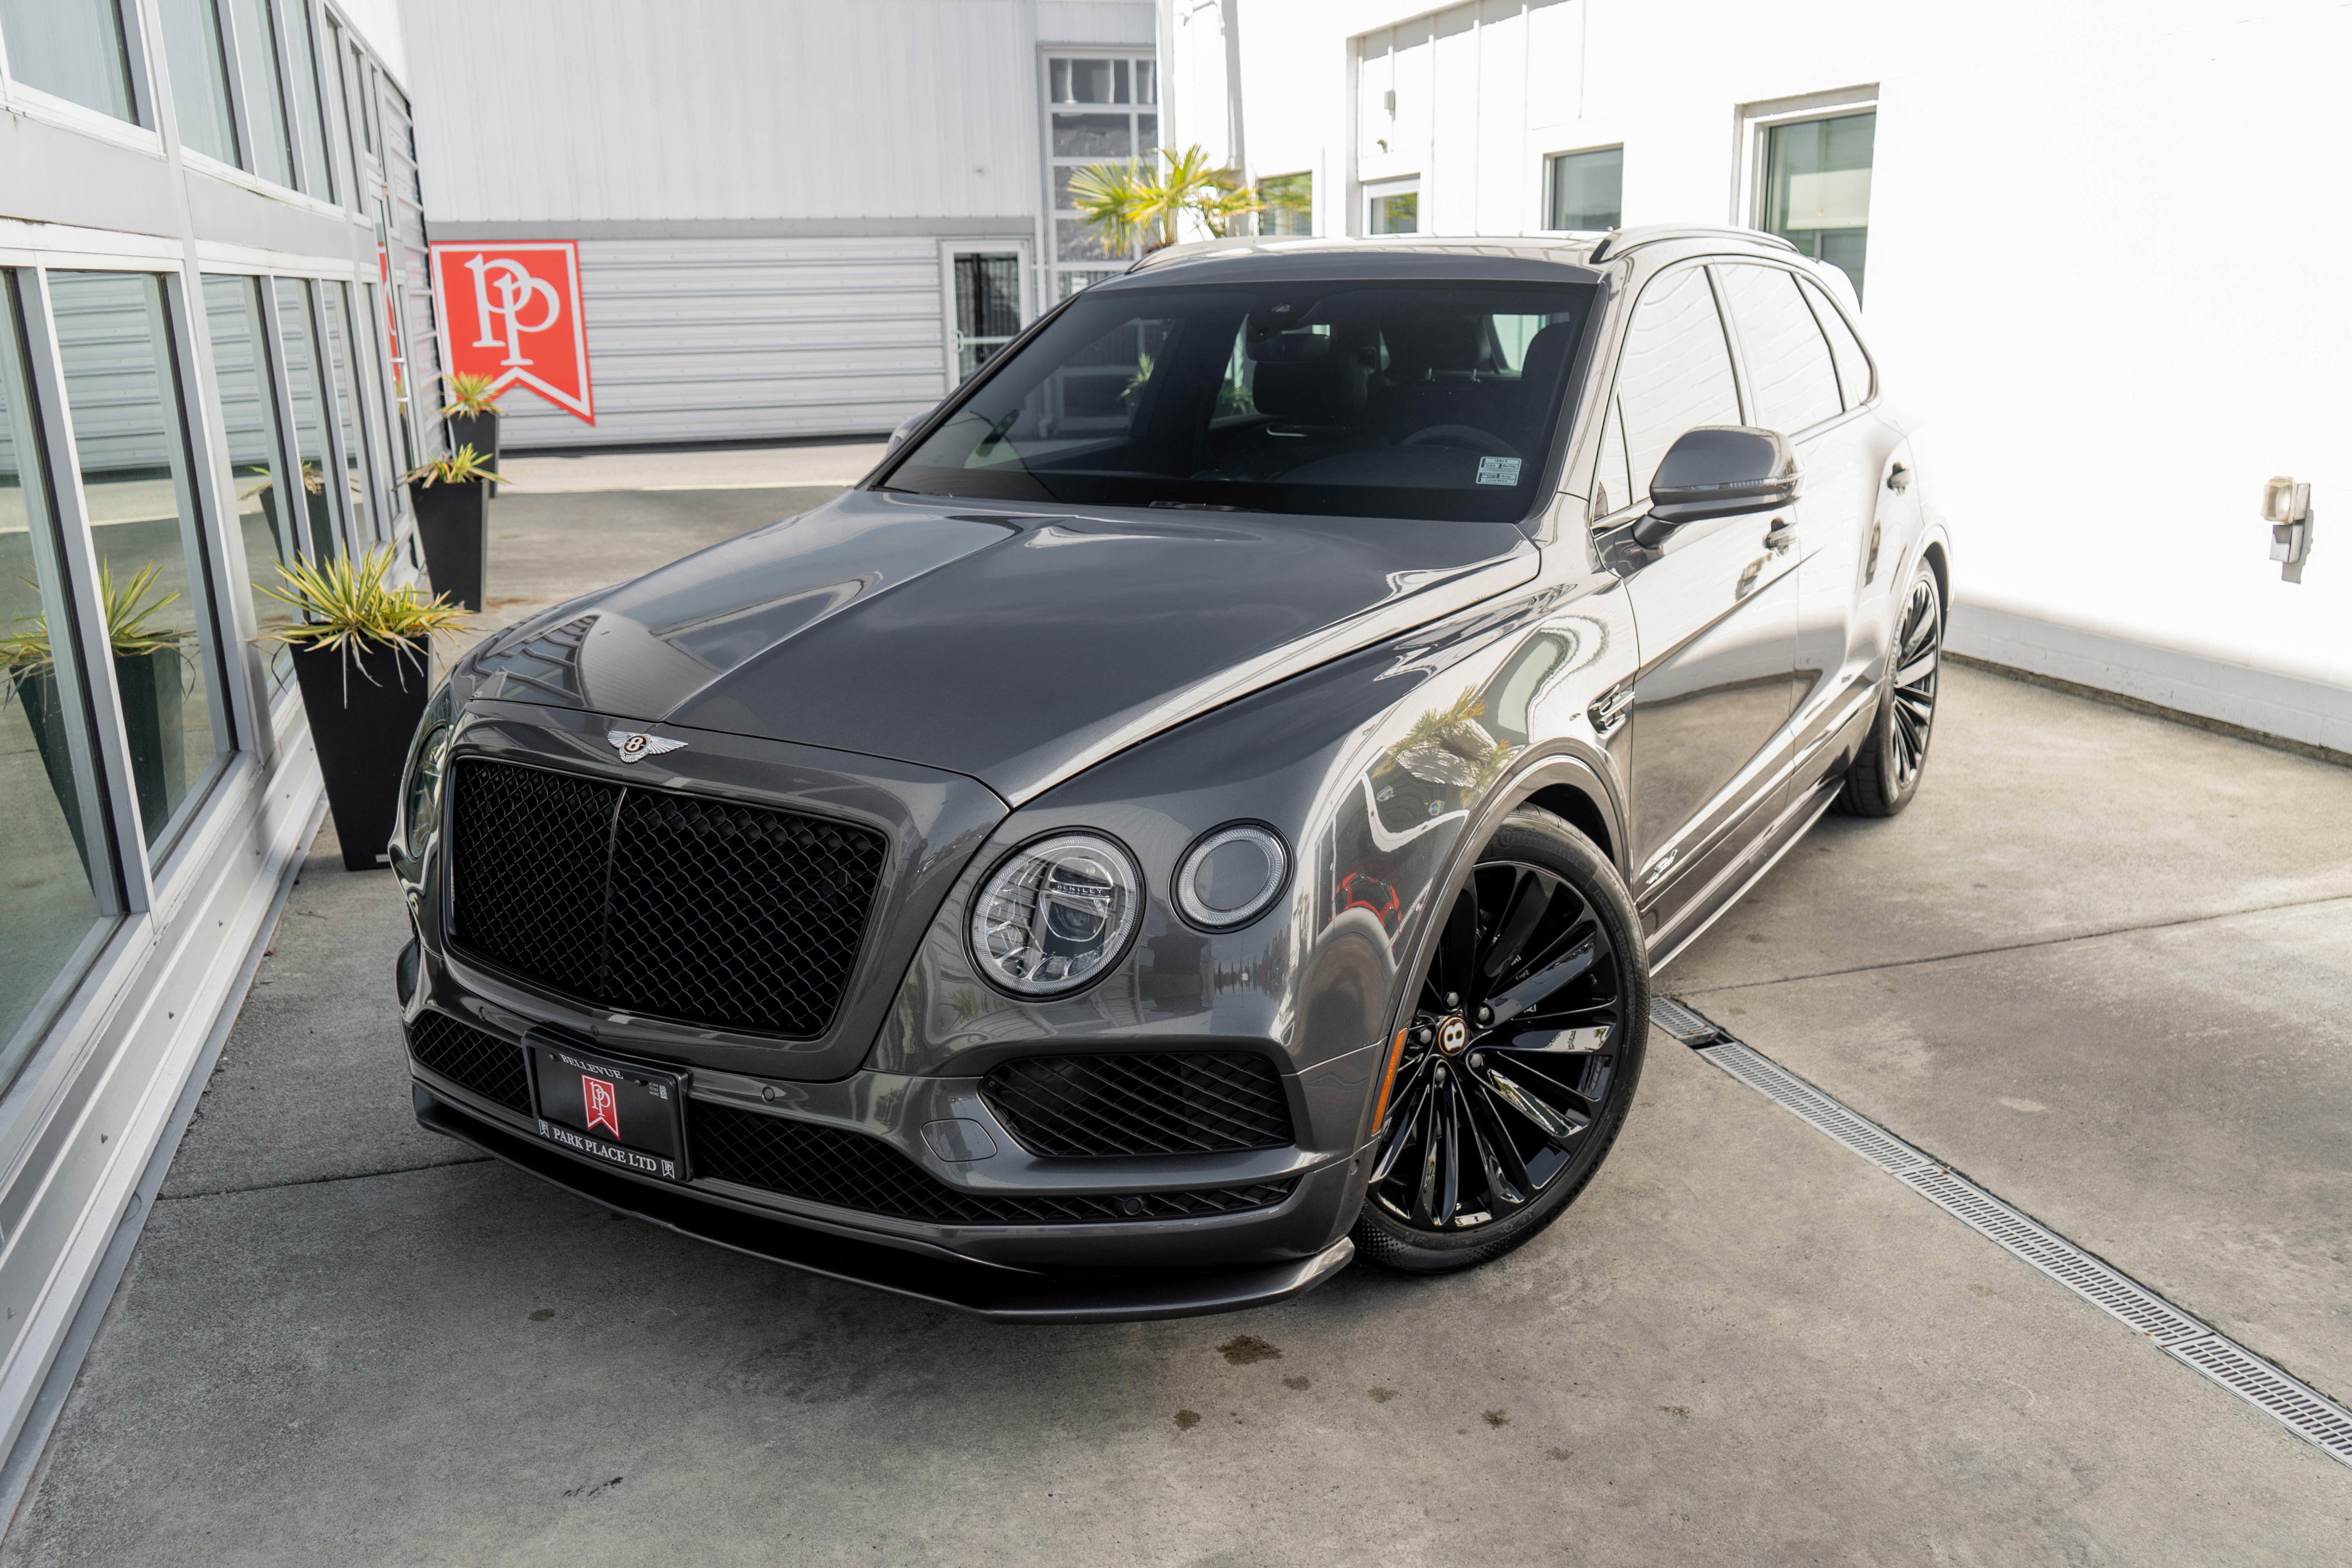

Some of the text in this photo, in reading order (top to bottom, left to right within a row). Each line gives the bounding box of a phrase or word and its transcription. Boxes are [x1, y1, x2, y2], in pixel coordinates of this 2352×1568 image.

[1057, 883, 1103, 893] BENTLEY
[559, 1054, 624, 1079] BELLEVUE
[552, 1127, 657, 1171] PARK PLACE LTD
